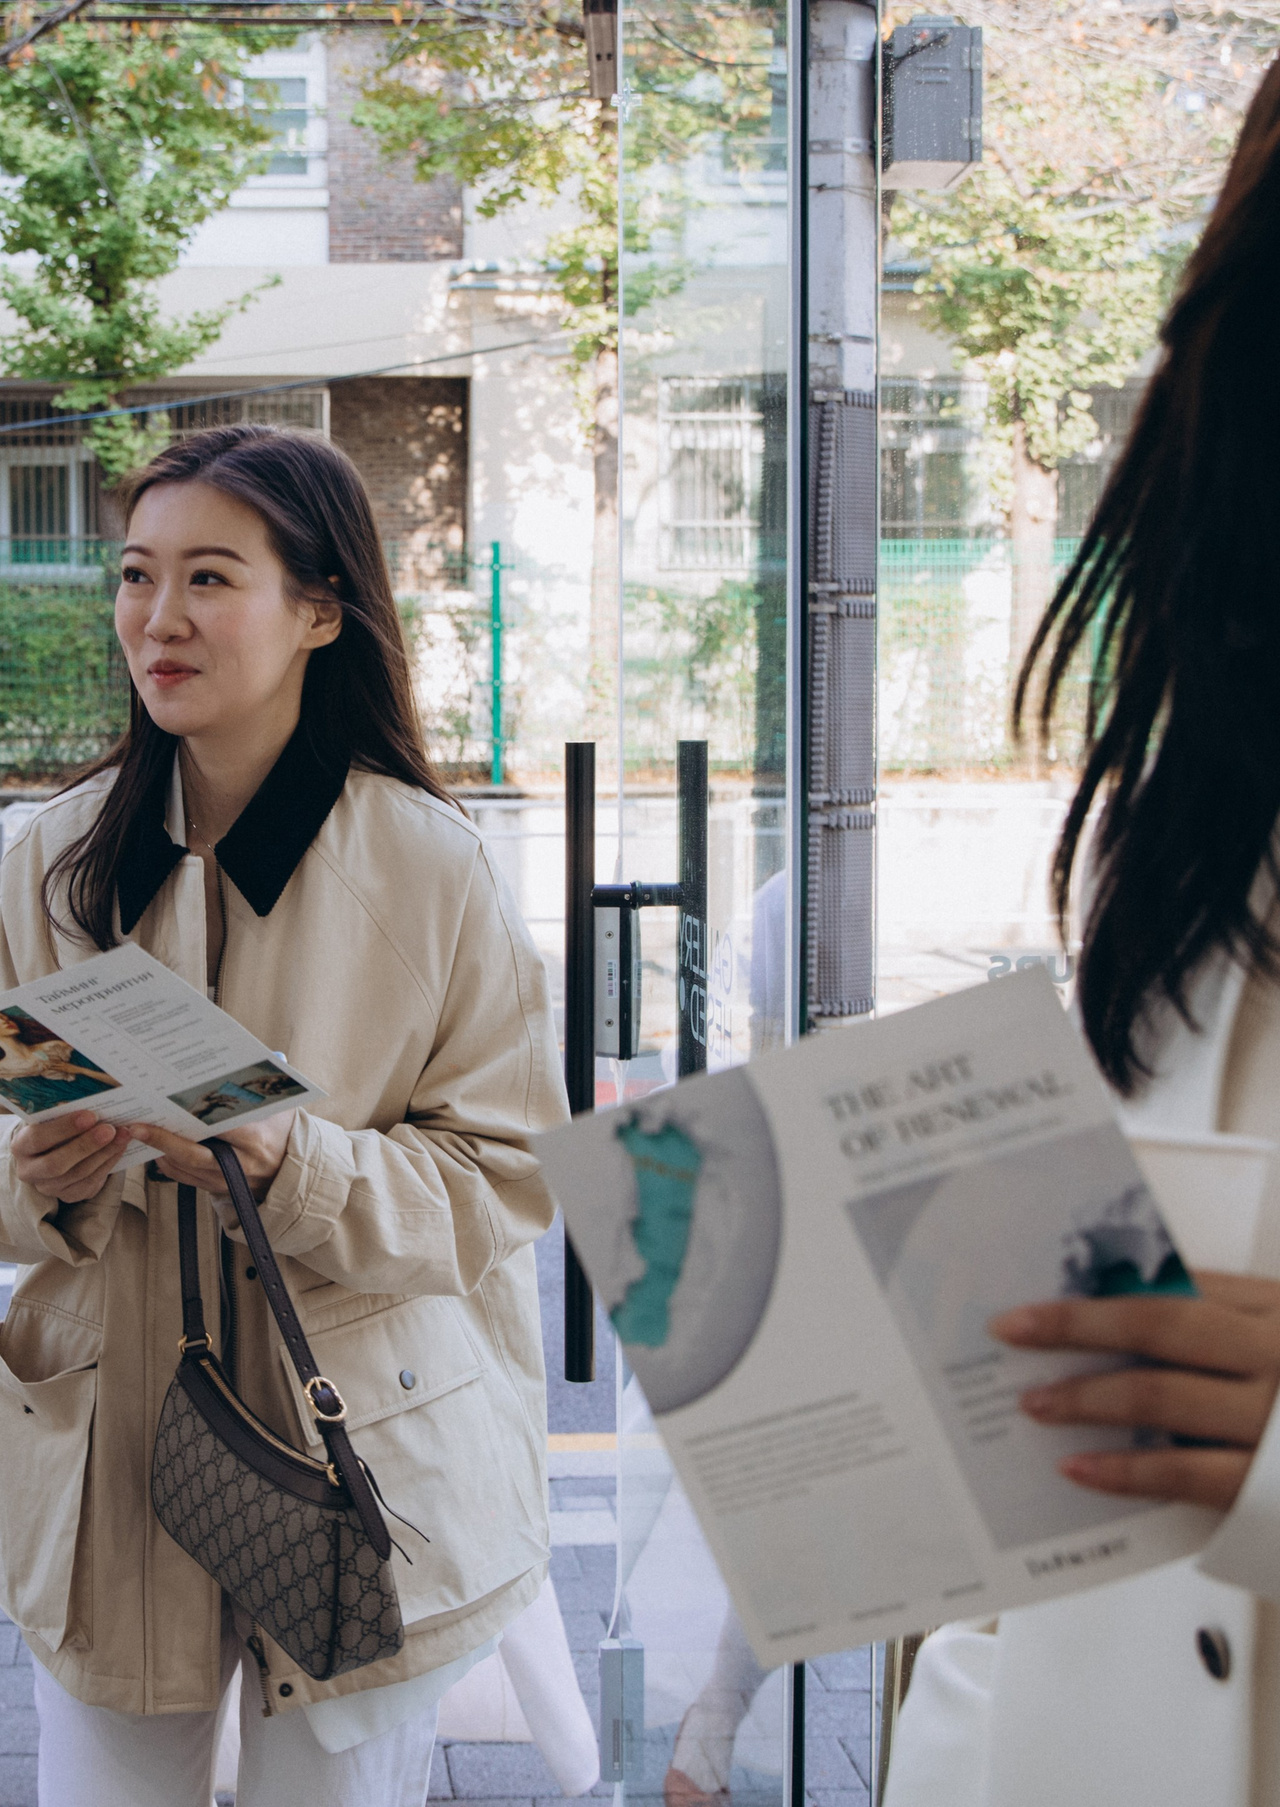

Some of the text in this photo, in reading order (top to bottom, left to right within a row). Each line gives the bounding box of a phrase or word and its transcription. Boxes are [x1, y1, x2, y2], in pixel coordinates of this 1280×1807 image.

[827, 1055, 971, 1120] THE ART
[841, 1126, 888, 1158] OF
